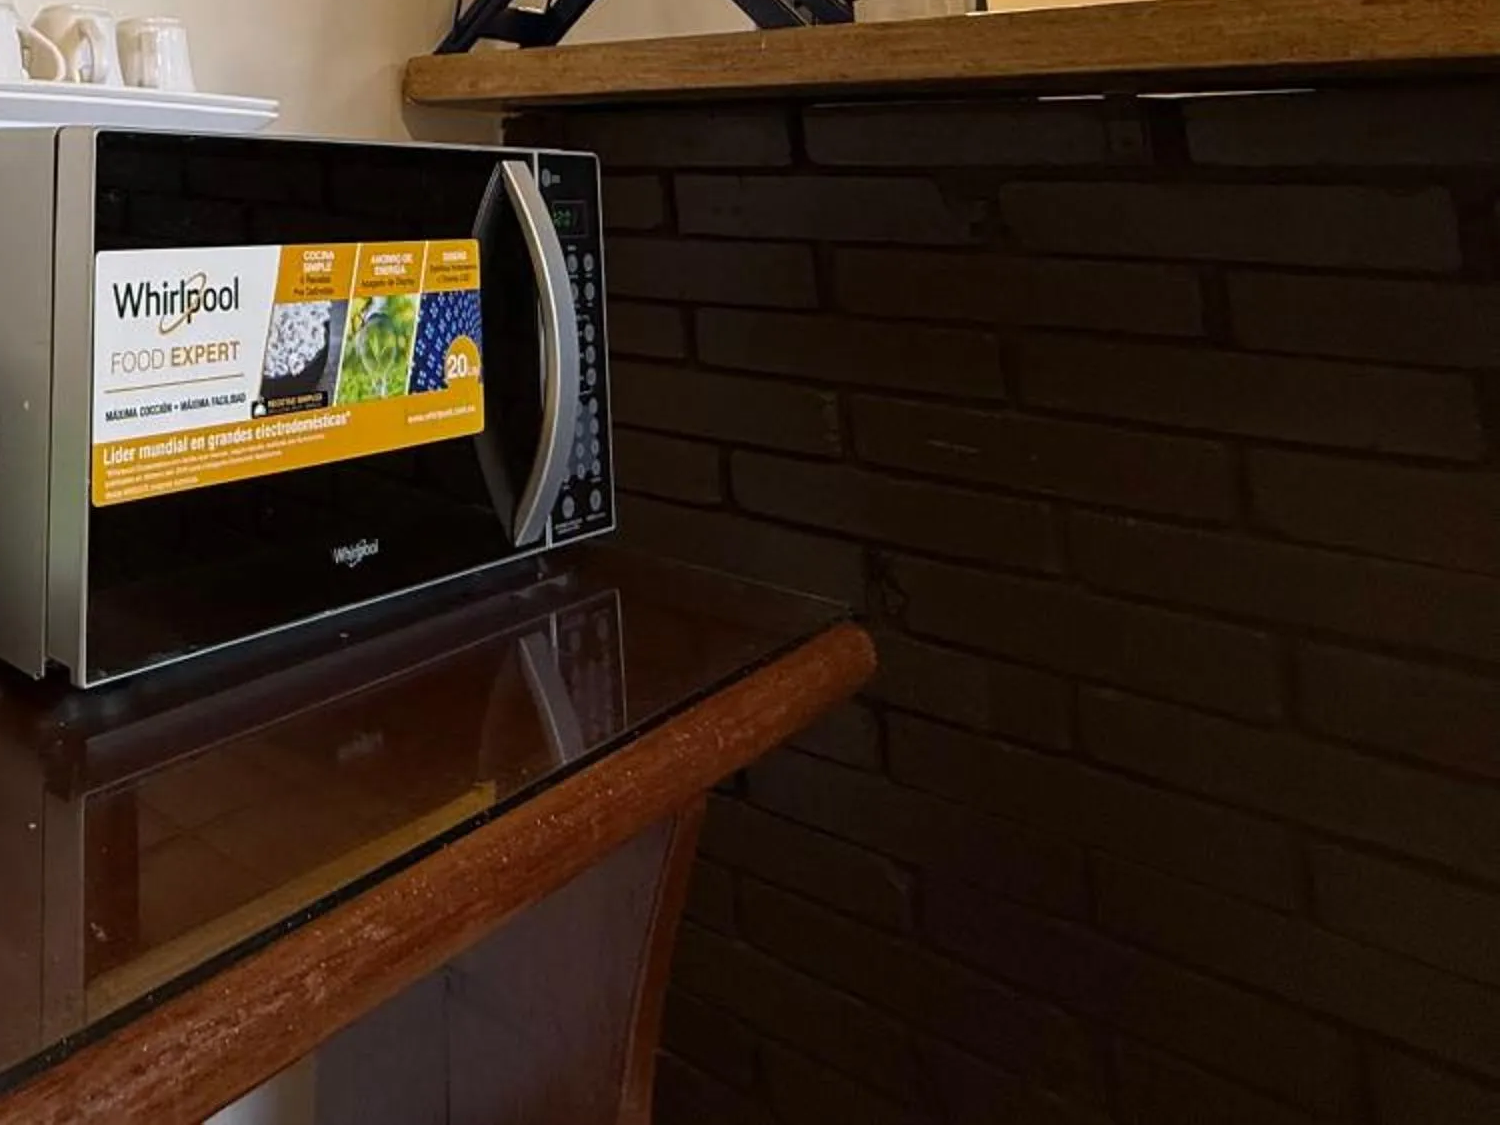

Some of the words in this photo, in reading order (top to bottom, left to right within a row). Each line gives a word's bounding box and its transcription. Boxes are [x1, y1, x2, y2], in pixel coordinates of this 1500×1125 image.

[113, 276, 239, 324] Whirlpool
[111, 349, 165, 374] FOOD
[171, 341, 241, 367] EXPERT
[447, 353, 468, 379] 20
[103, 446, 136, 466] Líder
[139, 434, 189, 460] mundial
[190, 435, 206, 451] en
[207, 426, 253, 452] grandes
